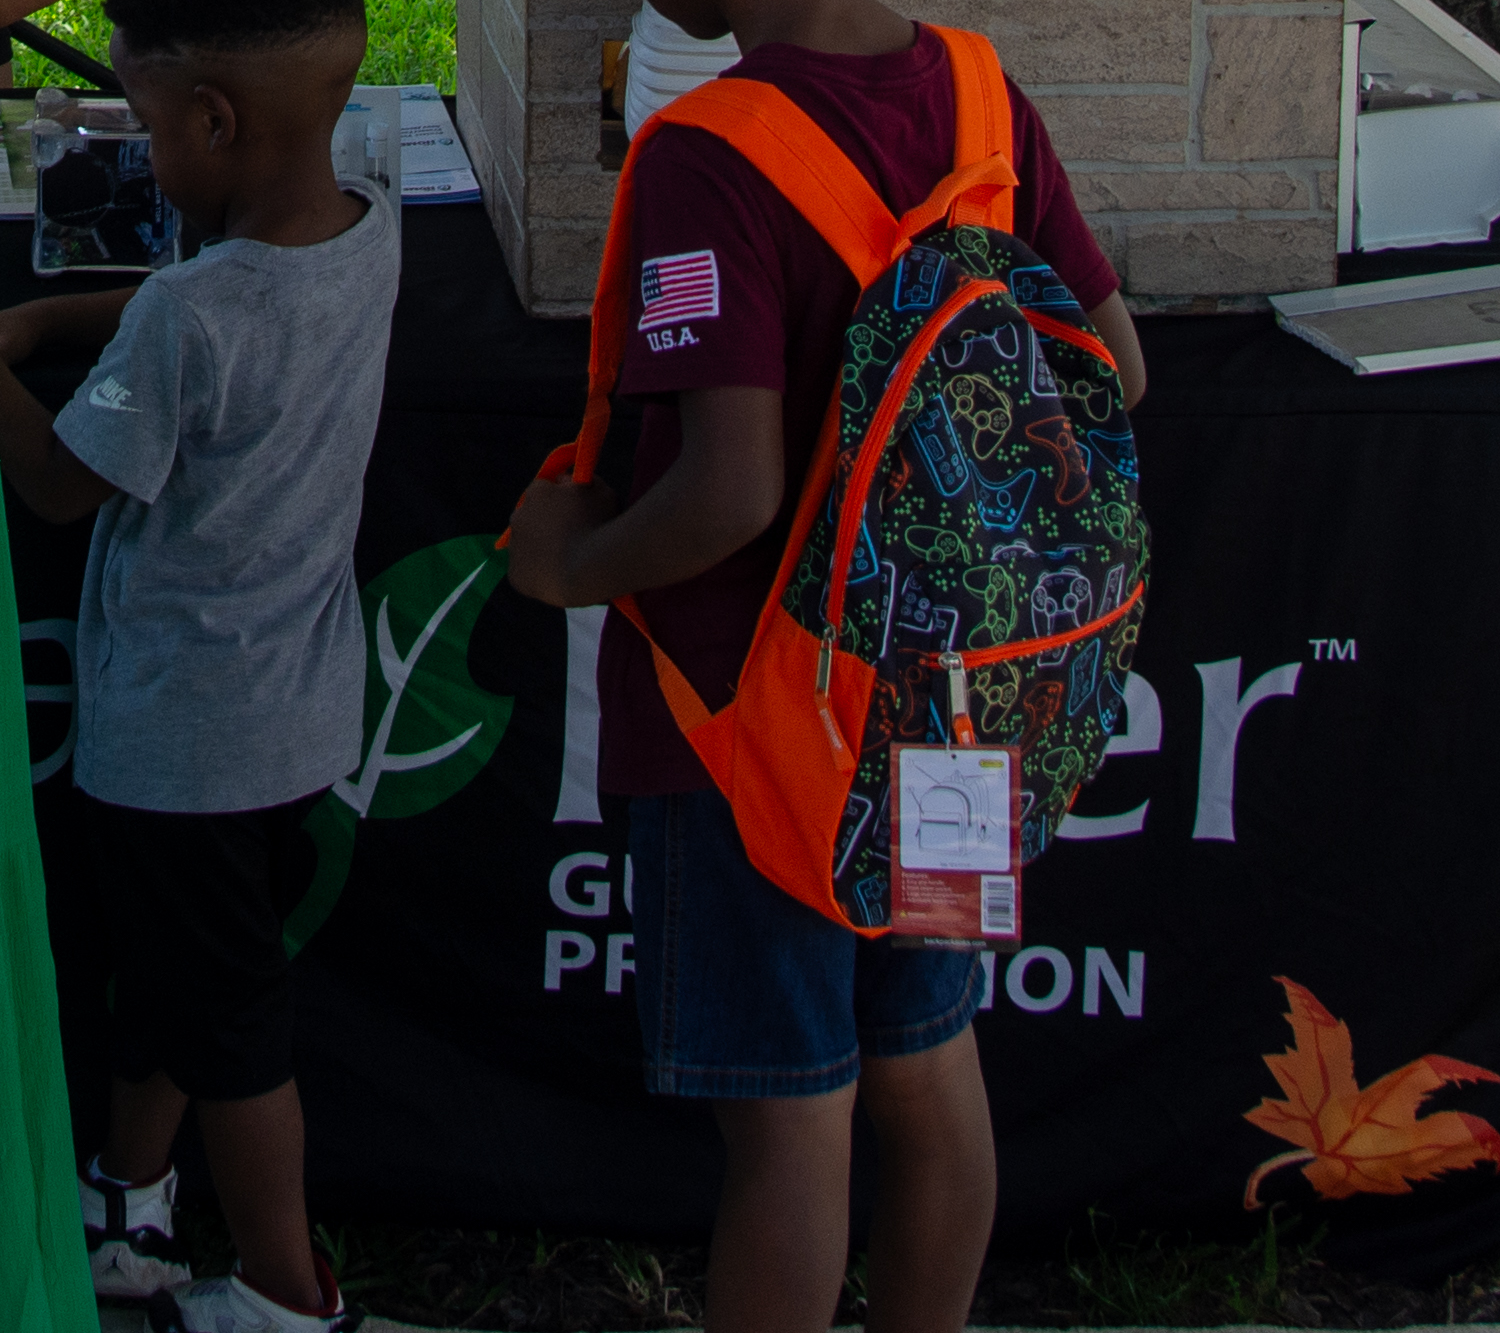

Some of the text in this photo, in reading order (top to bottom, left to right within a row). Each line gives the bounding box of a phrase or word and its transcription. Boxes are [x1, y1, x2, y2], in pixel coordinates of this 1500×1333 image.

[646, 326, 700, 352] U.S.A.
[99, 374, 133, 409] NIKE
[1308, 638, 1358, 662] TM
